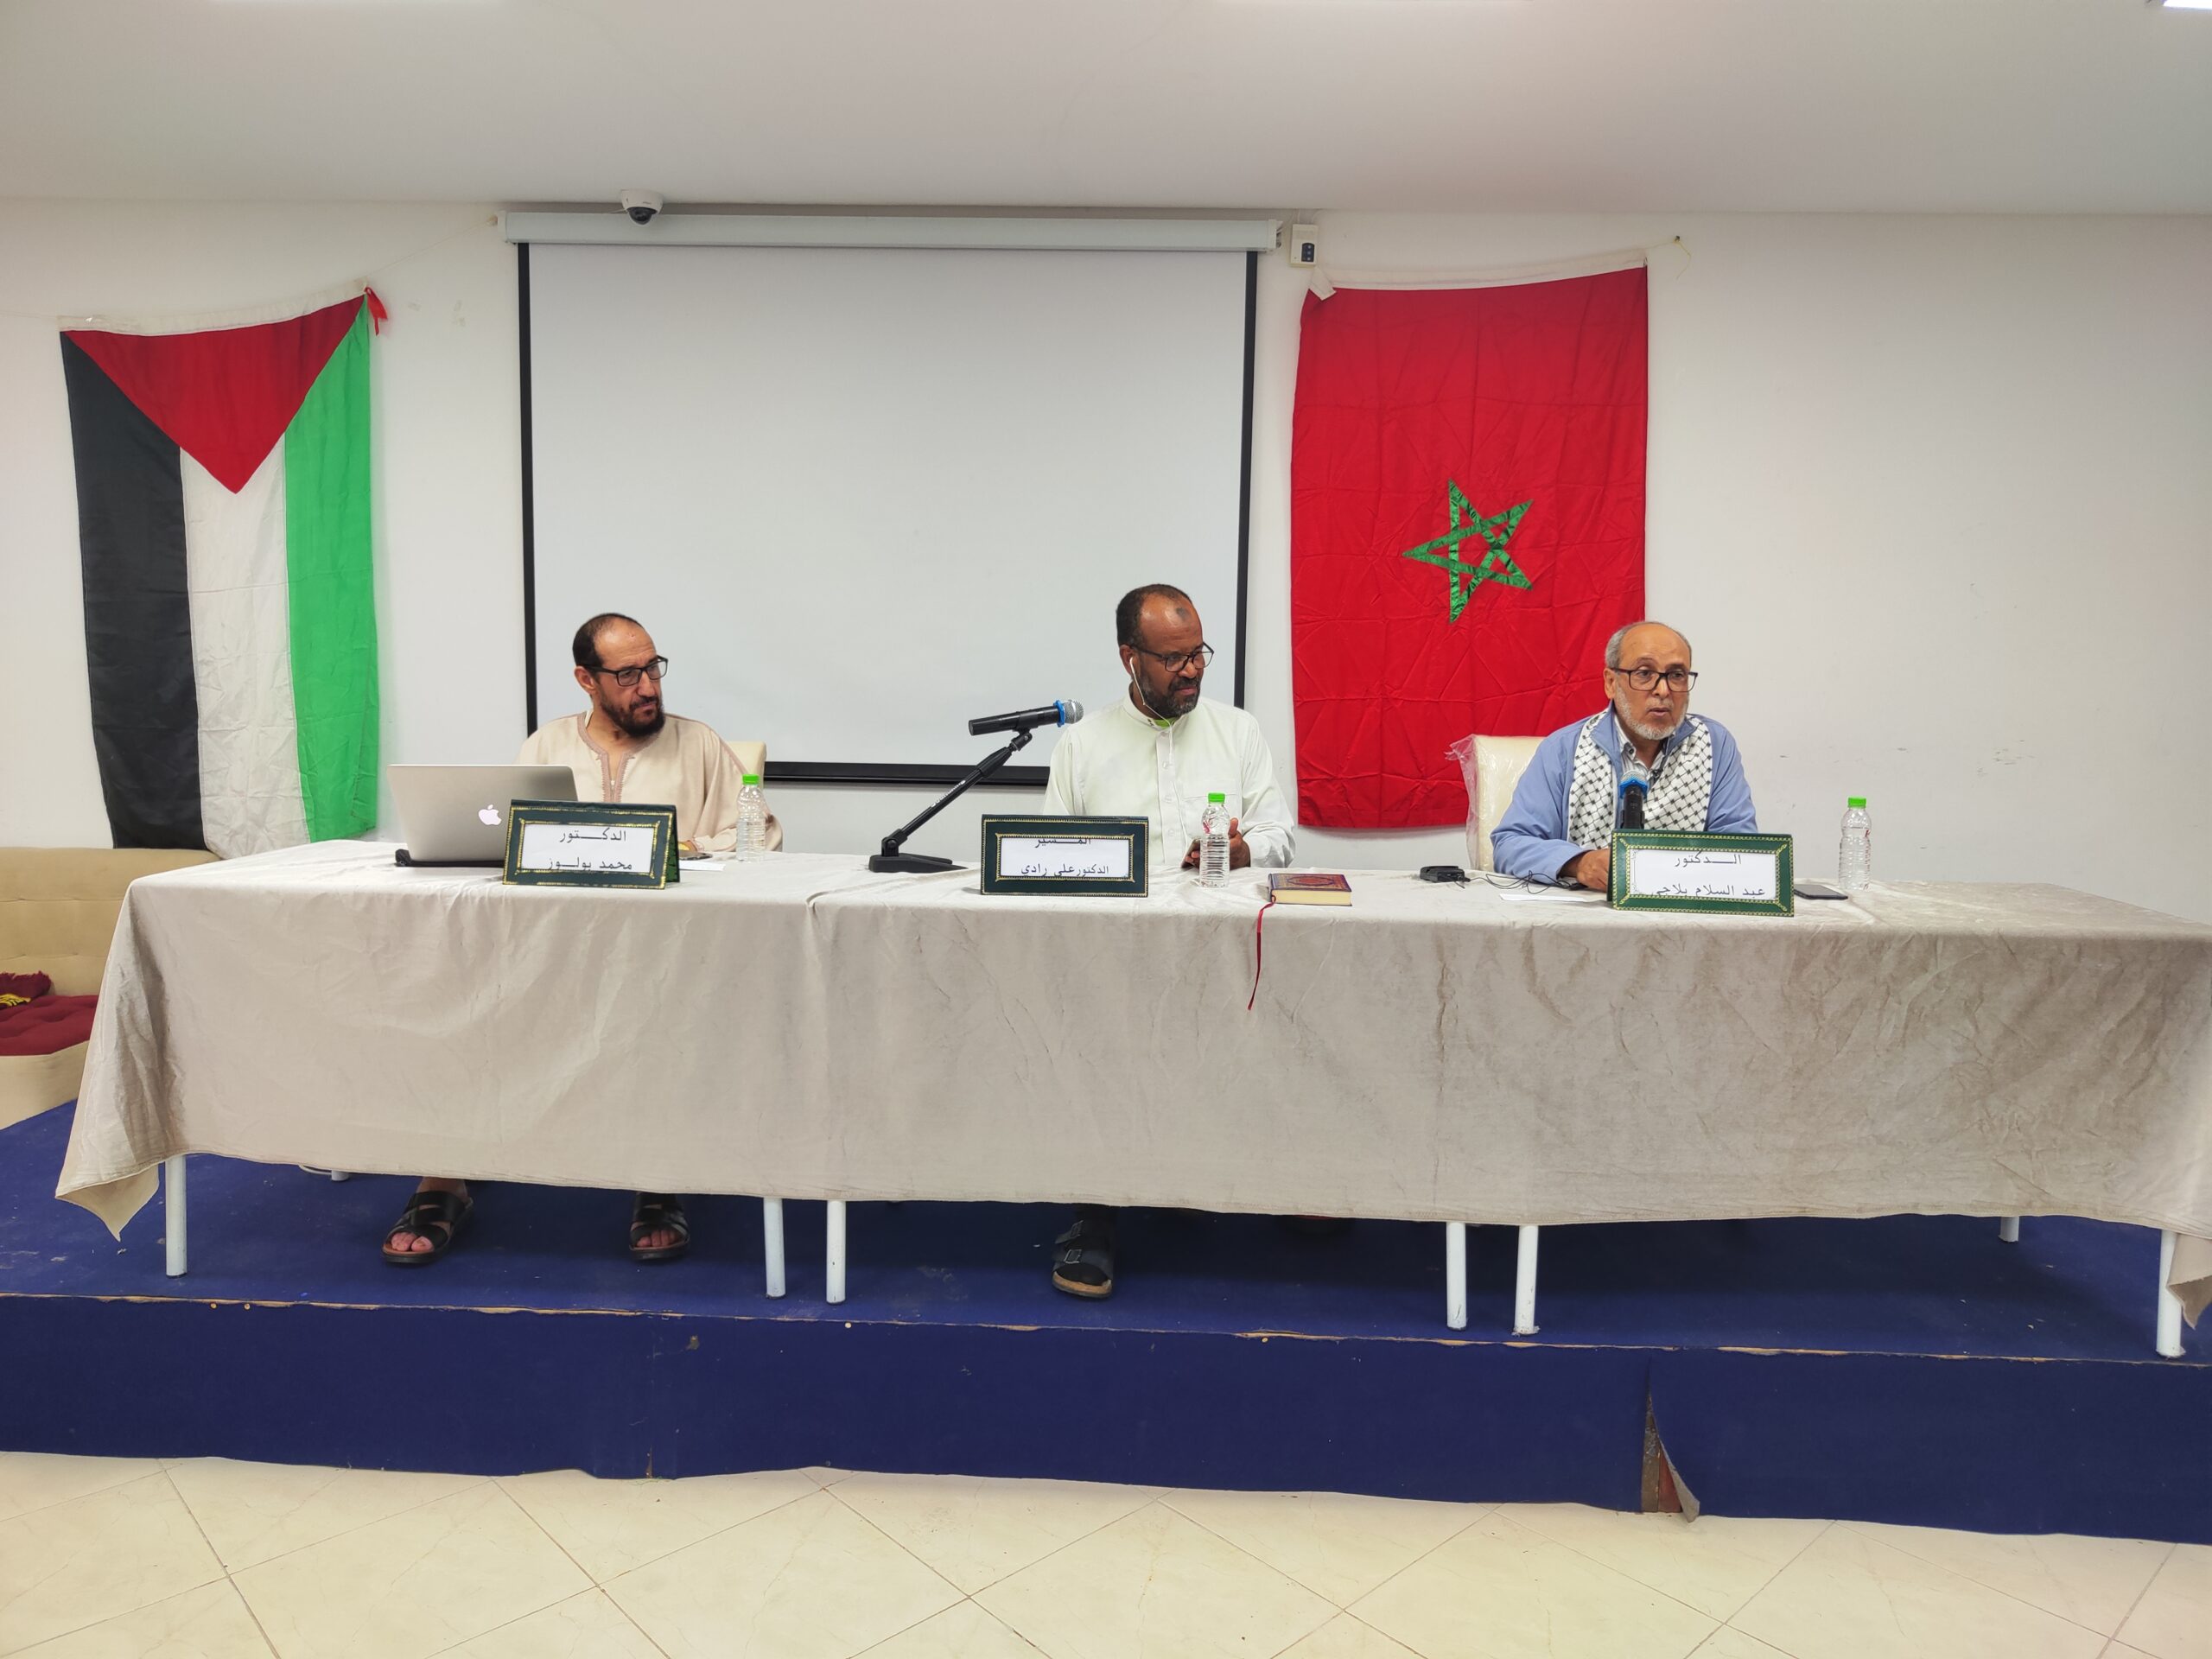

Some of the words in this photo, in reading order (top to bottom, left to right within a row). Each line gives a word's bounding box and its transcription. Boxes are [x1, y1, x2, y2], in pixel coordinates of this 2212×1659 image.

[559, 827, 626, 843] الدكتور
[599, 860, 632, 870] محمد
[1675, 850, 1742, 868] الدكتور
[1695, 884, 1735, 897] السلام
[1742, 887, 1765, 899] عبد
